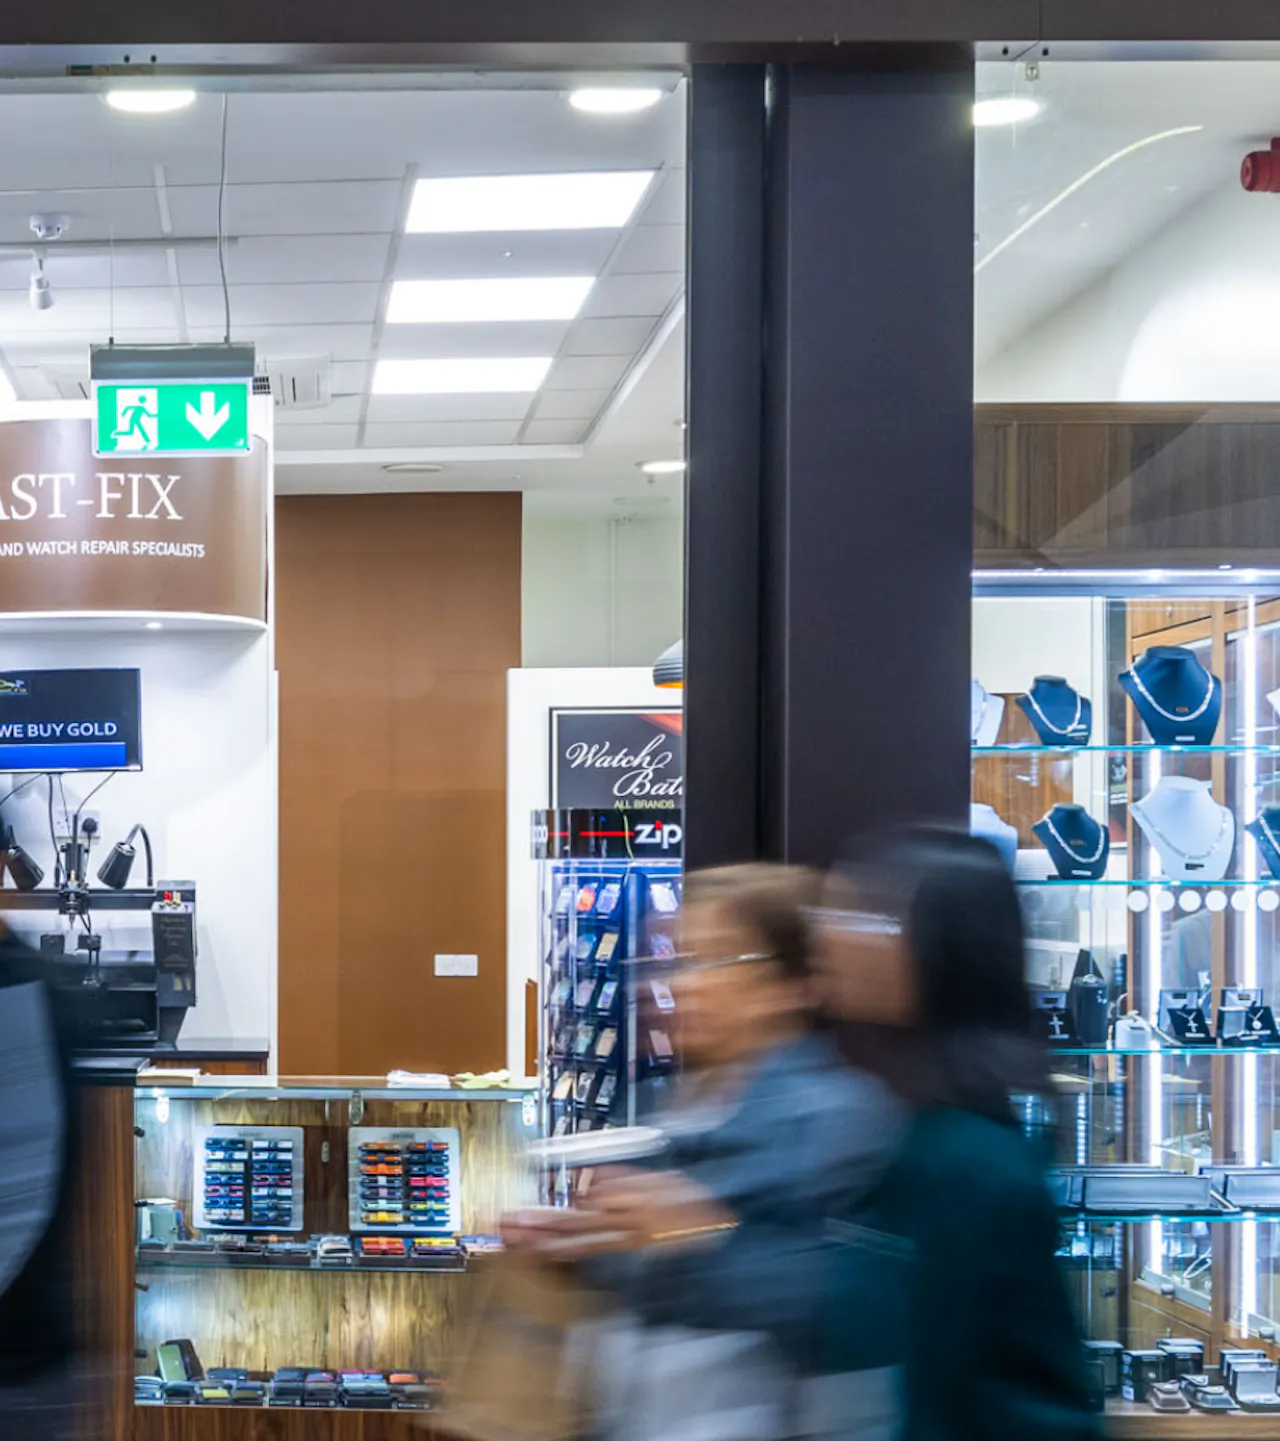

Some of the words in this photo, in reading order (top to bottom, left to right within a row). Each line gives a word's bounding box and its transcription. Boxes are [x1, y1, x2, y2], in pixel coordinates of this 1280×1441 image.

[26, 541, 77, 555] WATCH
[81, 541, 129, 555] REPAIR
[132, 541, 205, 558] SPECIALISTS
[27, 723, 64, 738] BUY
[67, 722, 118, 737] GOLD
[565, 733, 673, 769] Watch
[613, 769, 683, 796] Bat
[614, 799, 632, 810] ALL
[634, 799, 675, 810] BRANDS
